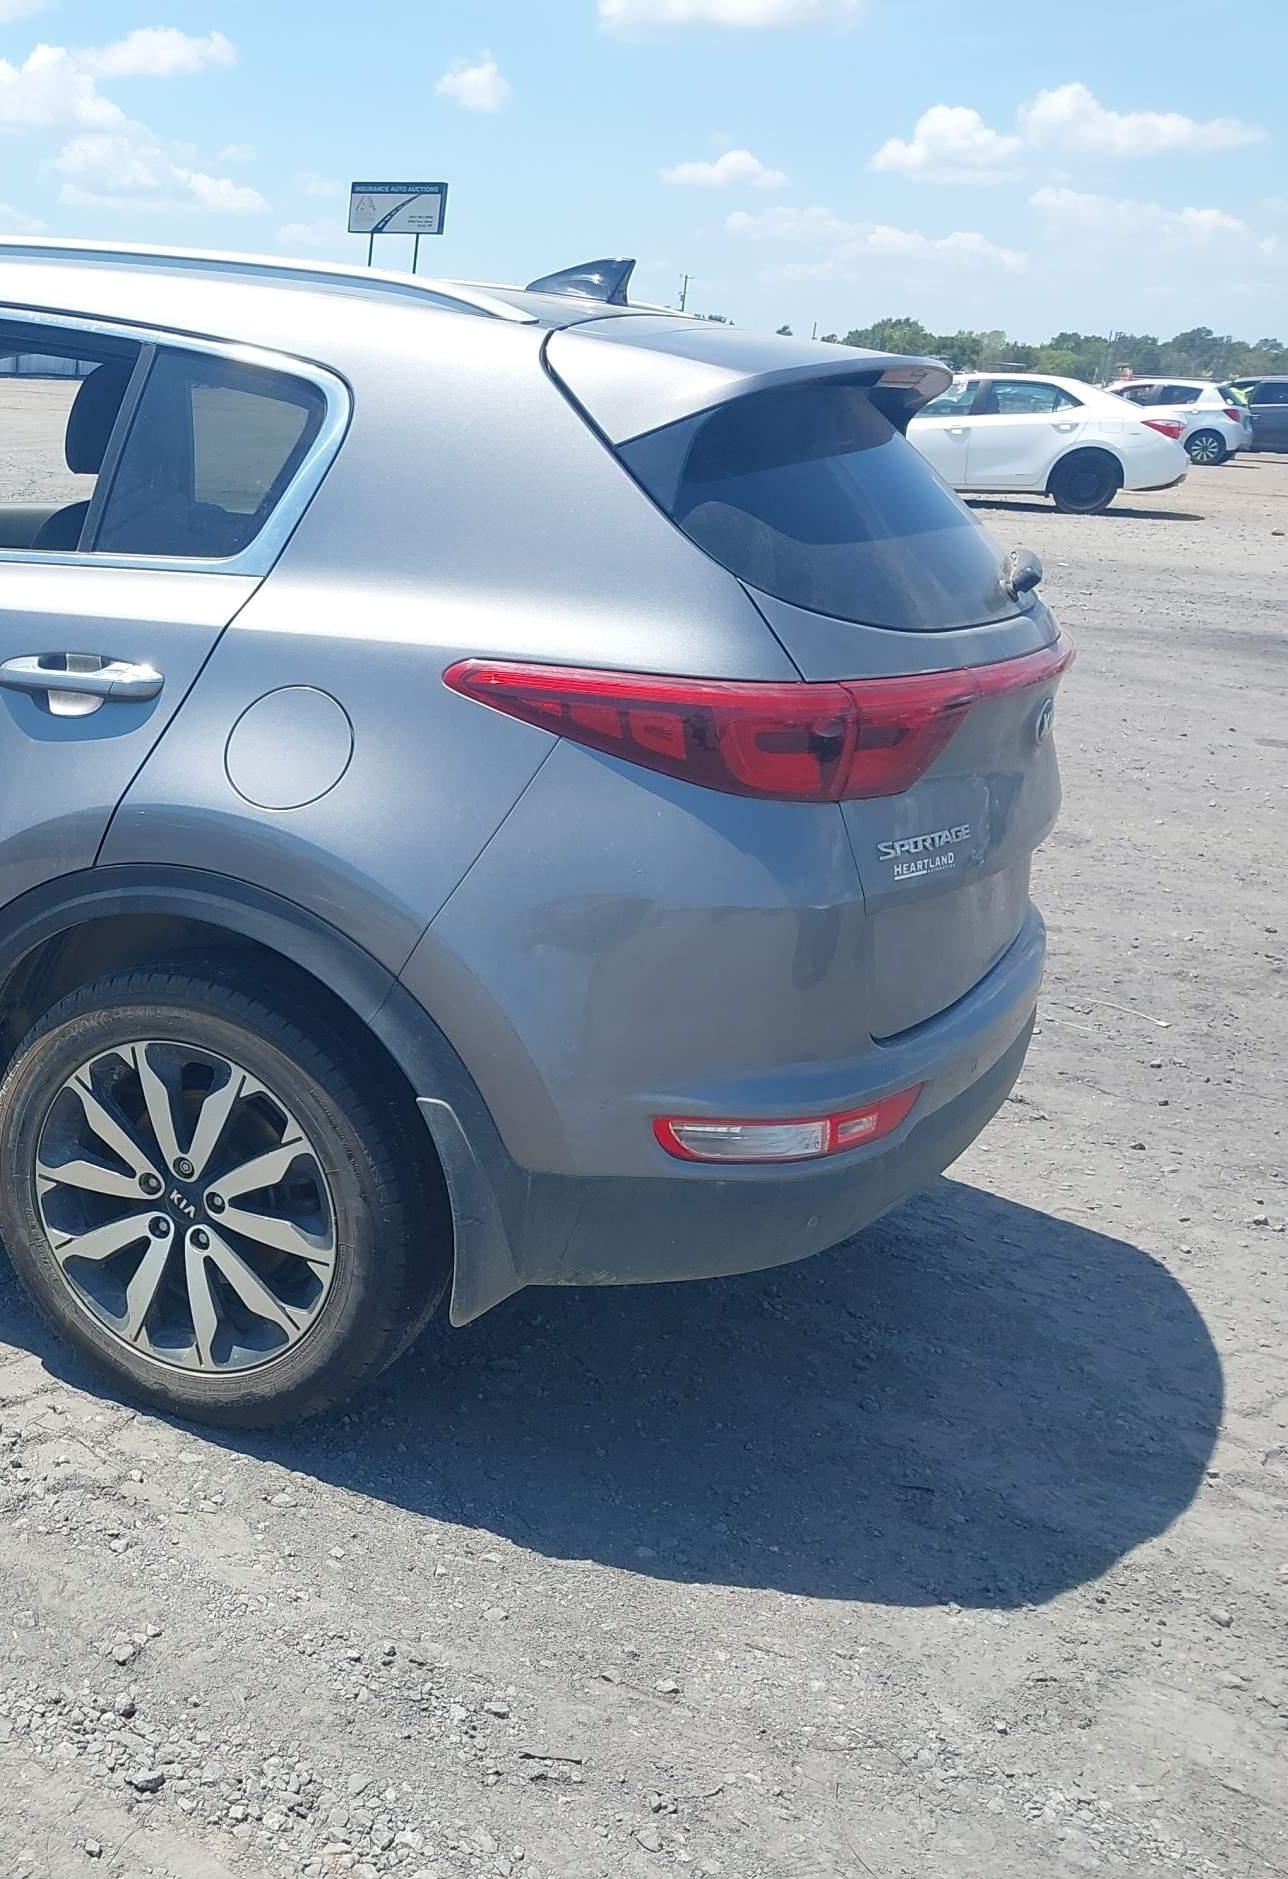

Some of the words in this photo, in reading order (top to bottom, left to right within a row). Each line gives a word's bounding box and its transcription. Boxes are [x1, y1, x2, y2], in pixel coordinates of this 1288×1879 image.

[877, 823, 971, 861] SPORTAGE
[894, 852, 955, 876] HEARTLAND
[169, 1188, 196, 1219] KIA
